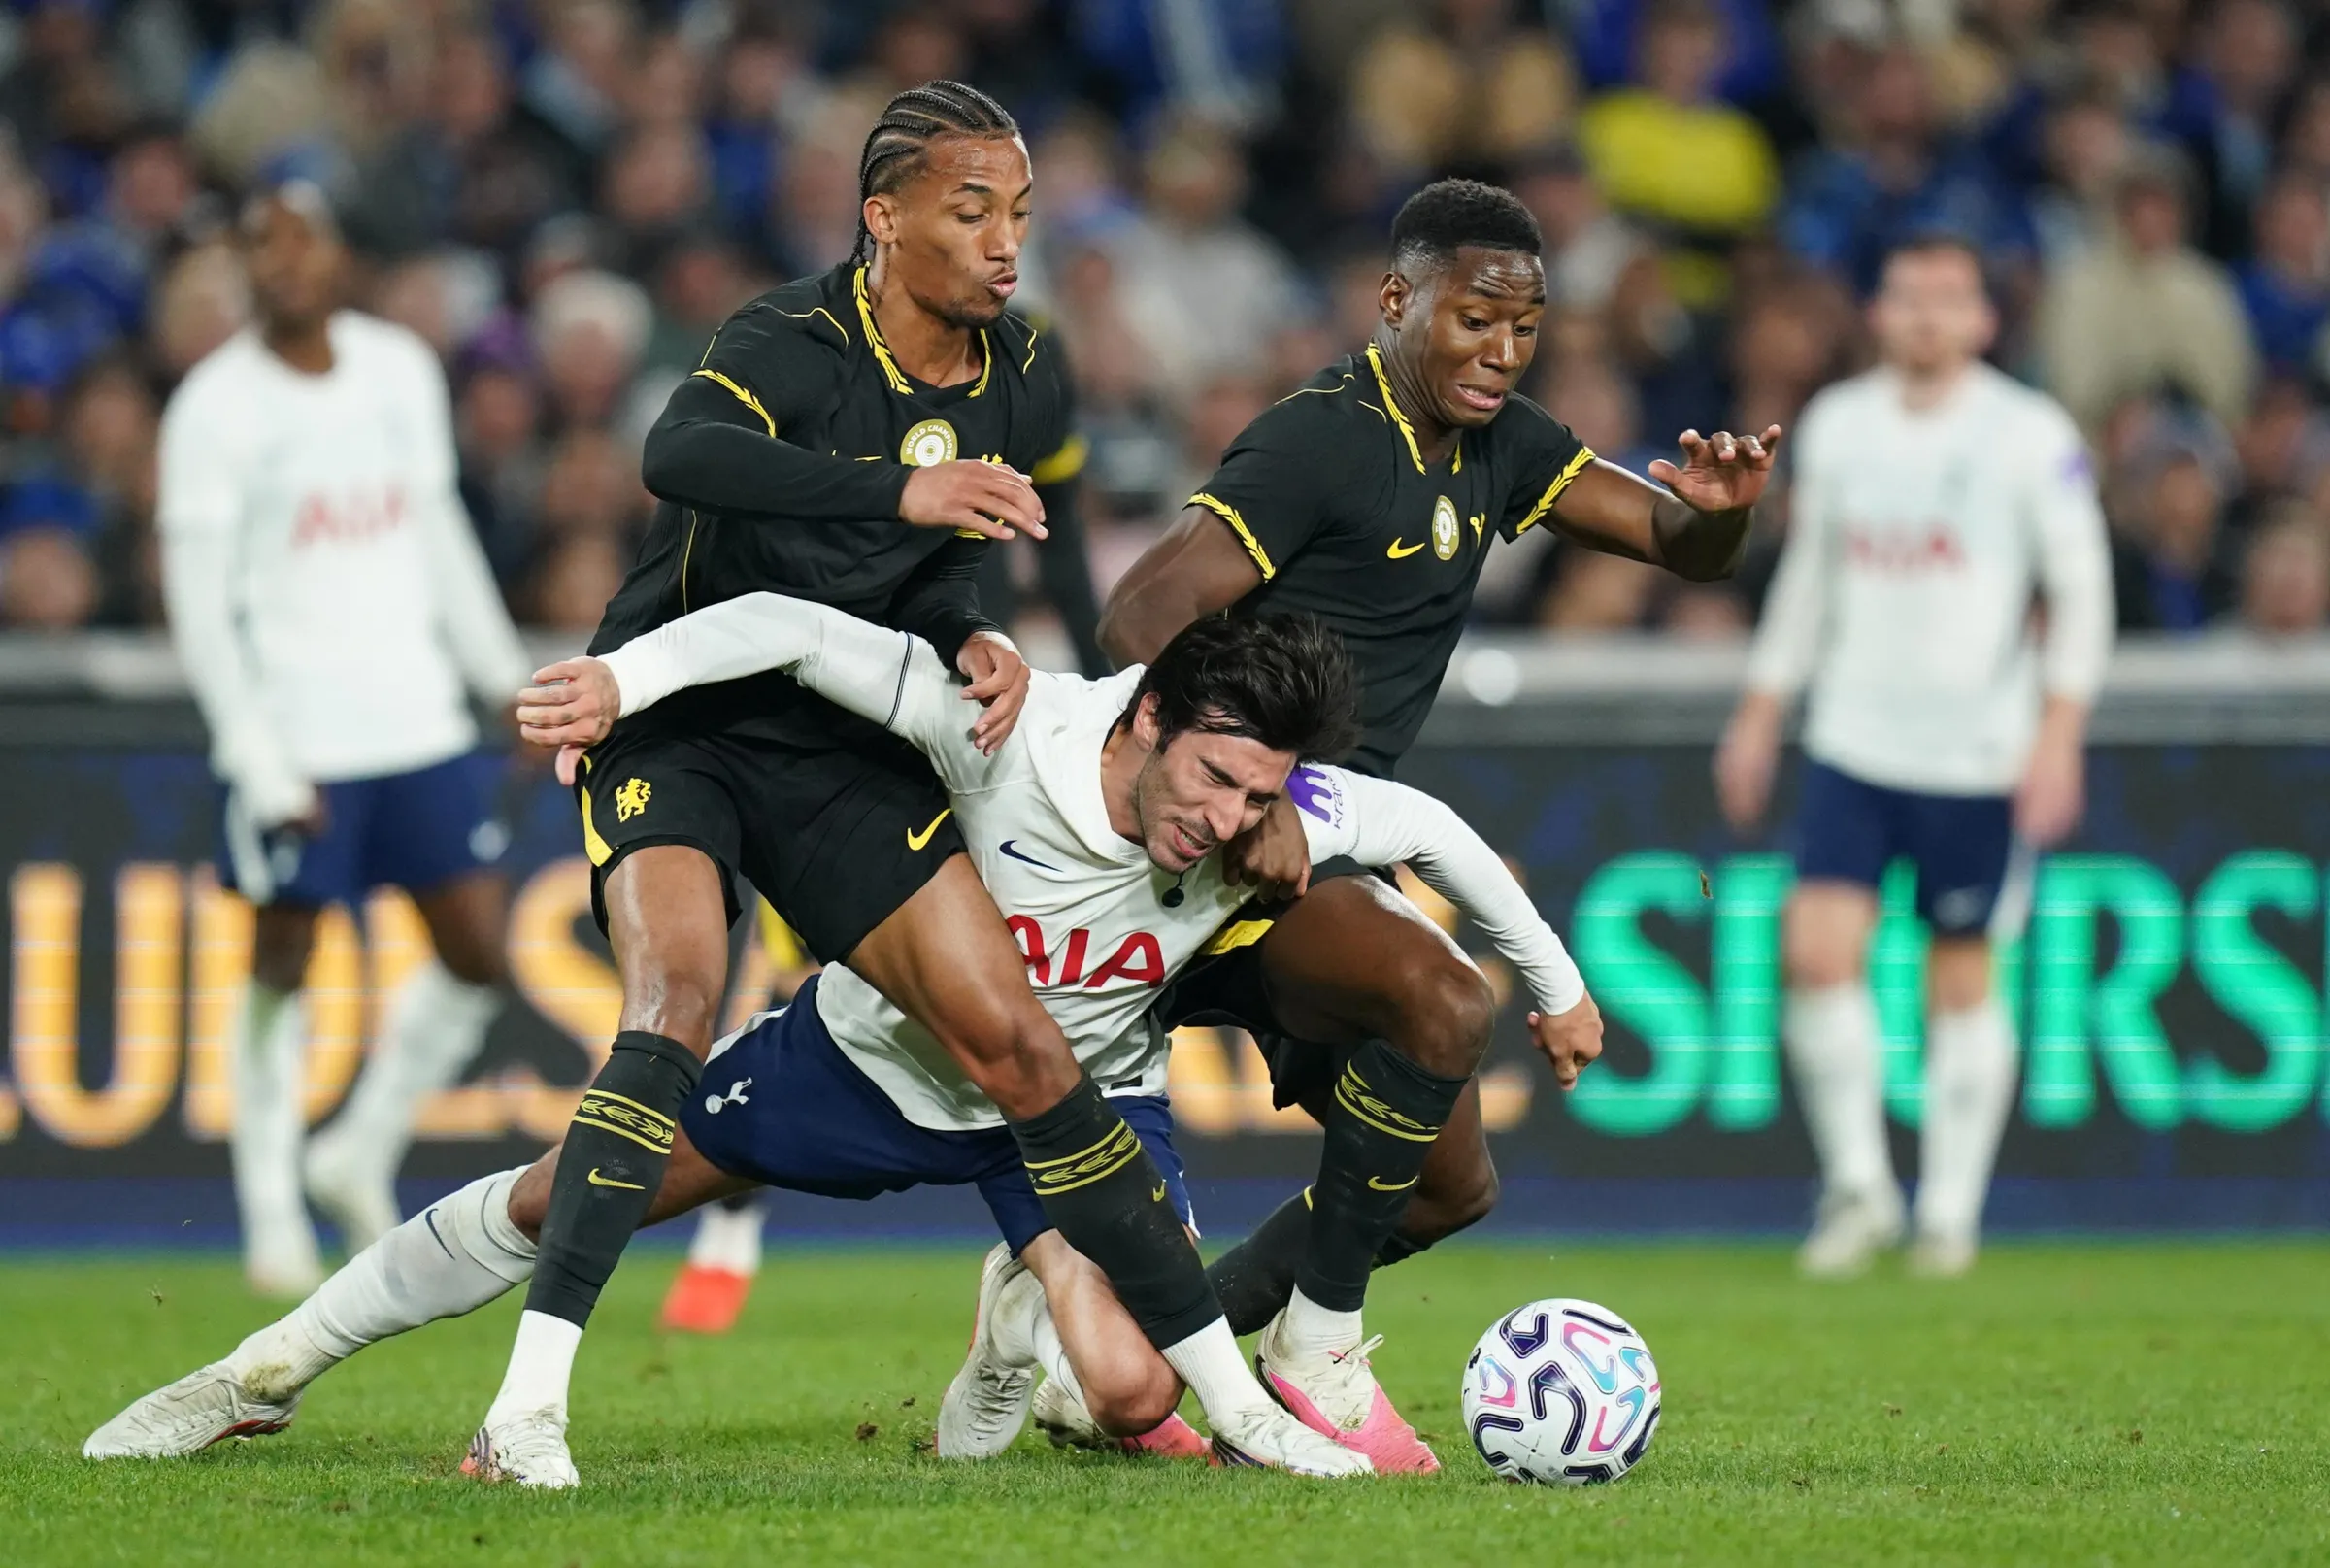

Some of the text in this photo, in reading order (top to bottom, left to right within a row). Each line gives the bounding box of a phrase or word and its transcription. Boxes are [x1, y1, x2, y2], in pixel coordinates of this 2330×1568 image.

[906, 424, 953, 462] WORLD CHAMPIONS
[1005, 914, 1165, 988] AIA
